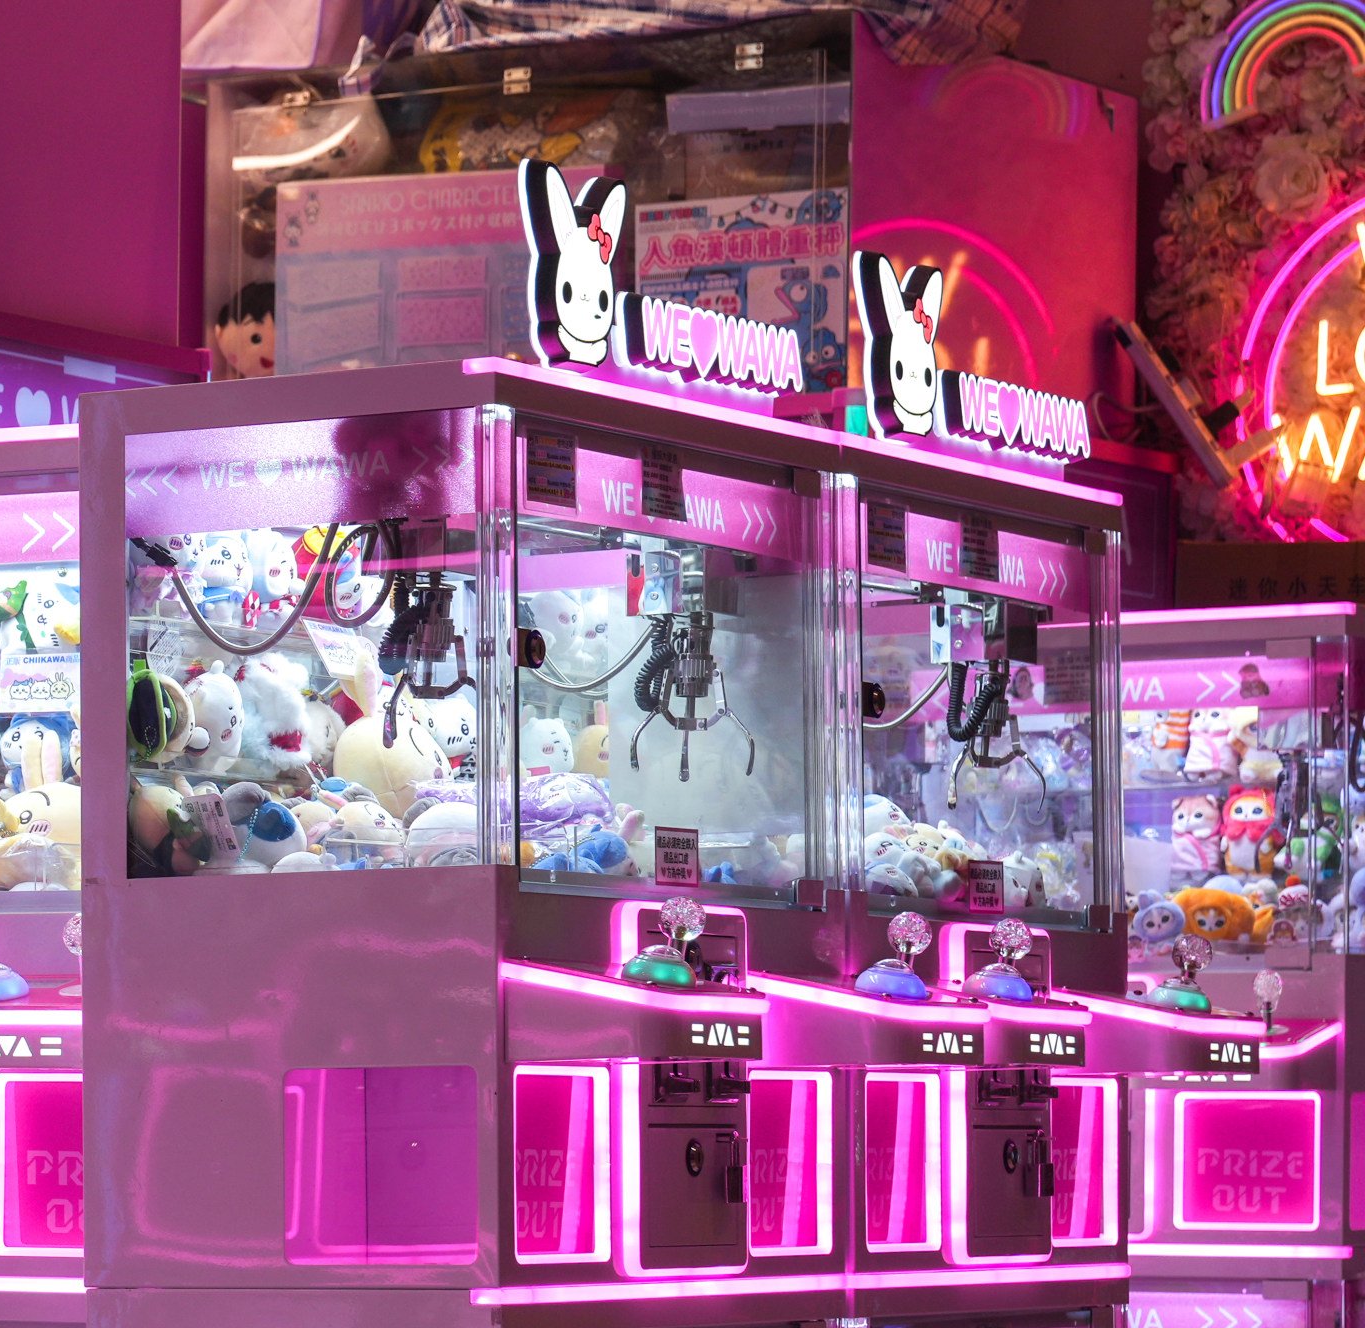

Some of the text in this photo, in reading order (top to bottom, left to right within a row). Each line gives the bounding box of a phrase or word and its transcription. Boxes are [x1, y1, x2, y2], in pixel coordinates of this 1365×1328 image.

[642, 295, 802, 393] WE WAWA
[959, 372, 1090, 458] WE WAWA
[200, 447, 390, 490] WE WAWA
[602, 479, 635, 515] WE
[681, 494, 725, 533] AWA
[926, 538, 953, 574] WE
[1000, 552, 1026, 588] WA
[1122, 677, 1166, 703] WA
[1196, 1147, 1304, 1178] PRIZE
[1210, 1184, 1288, 1214] OUT
